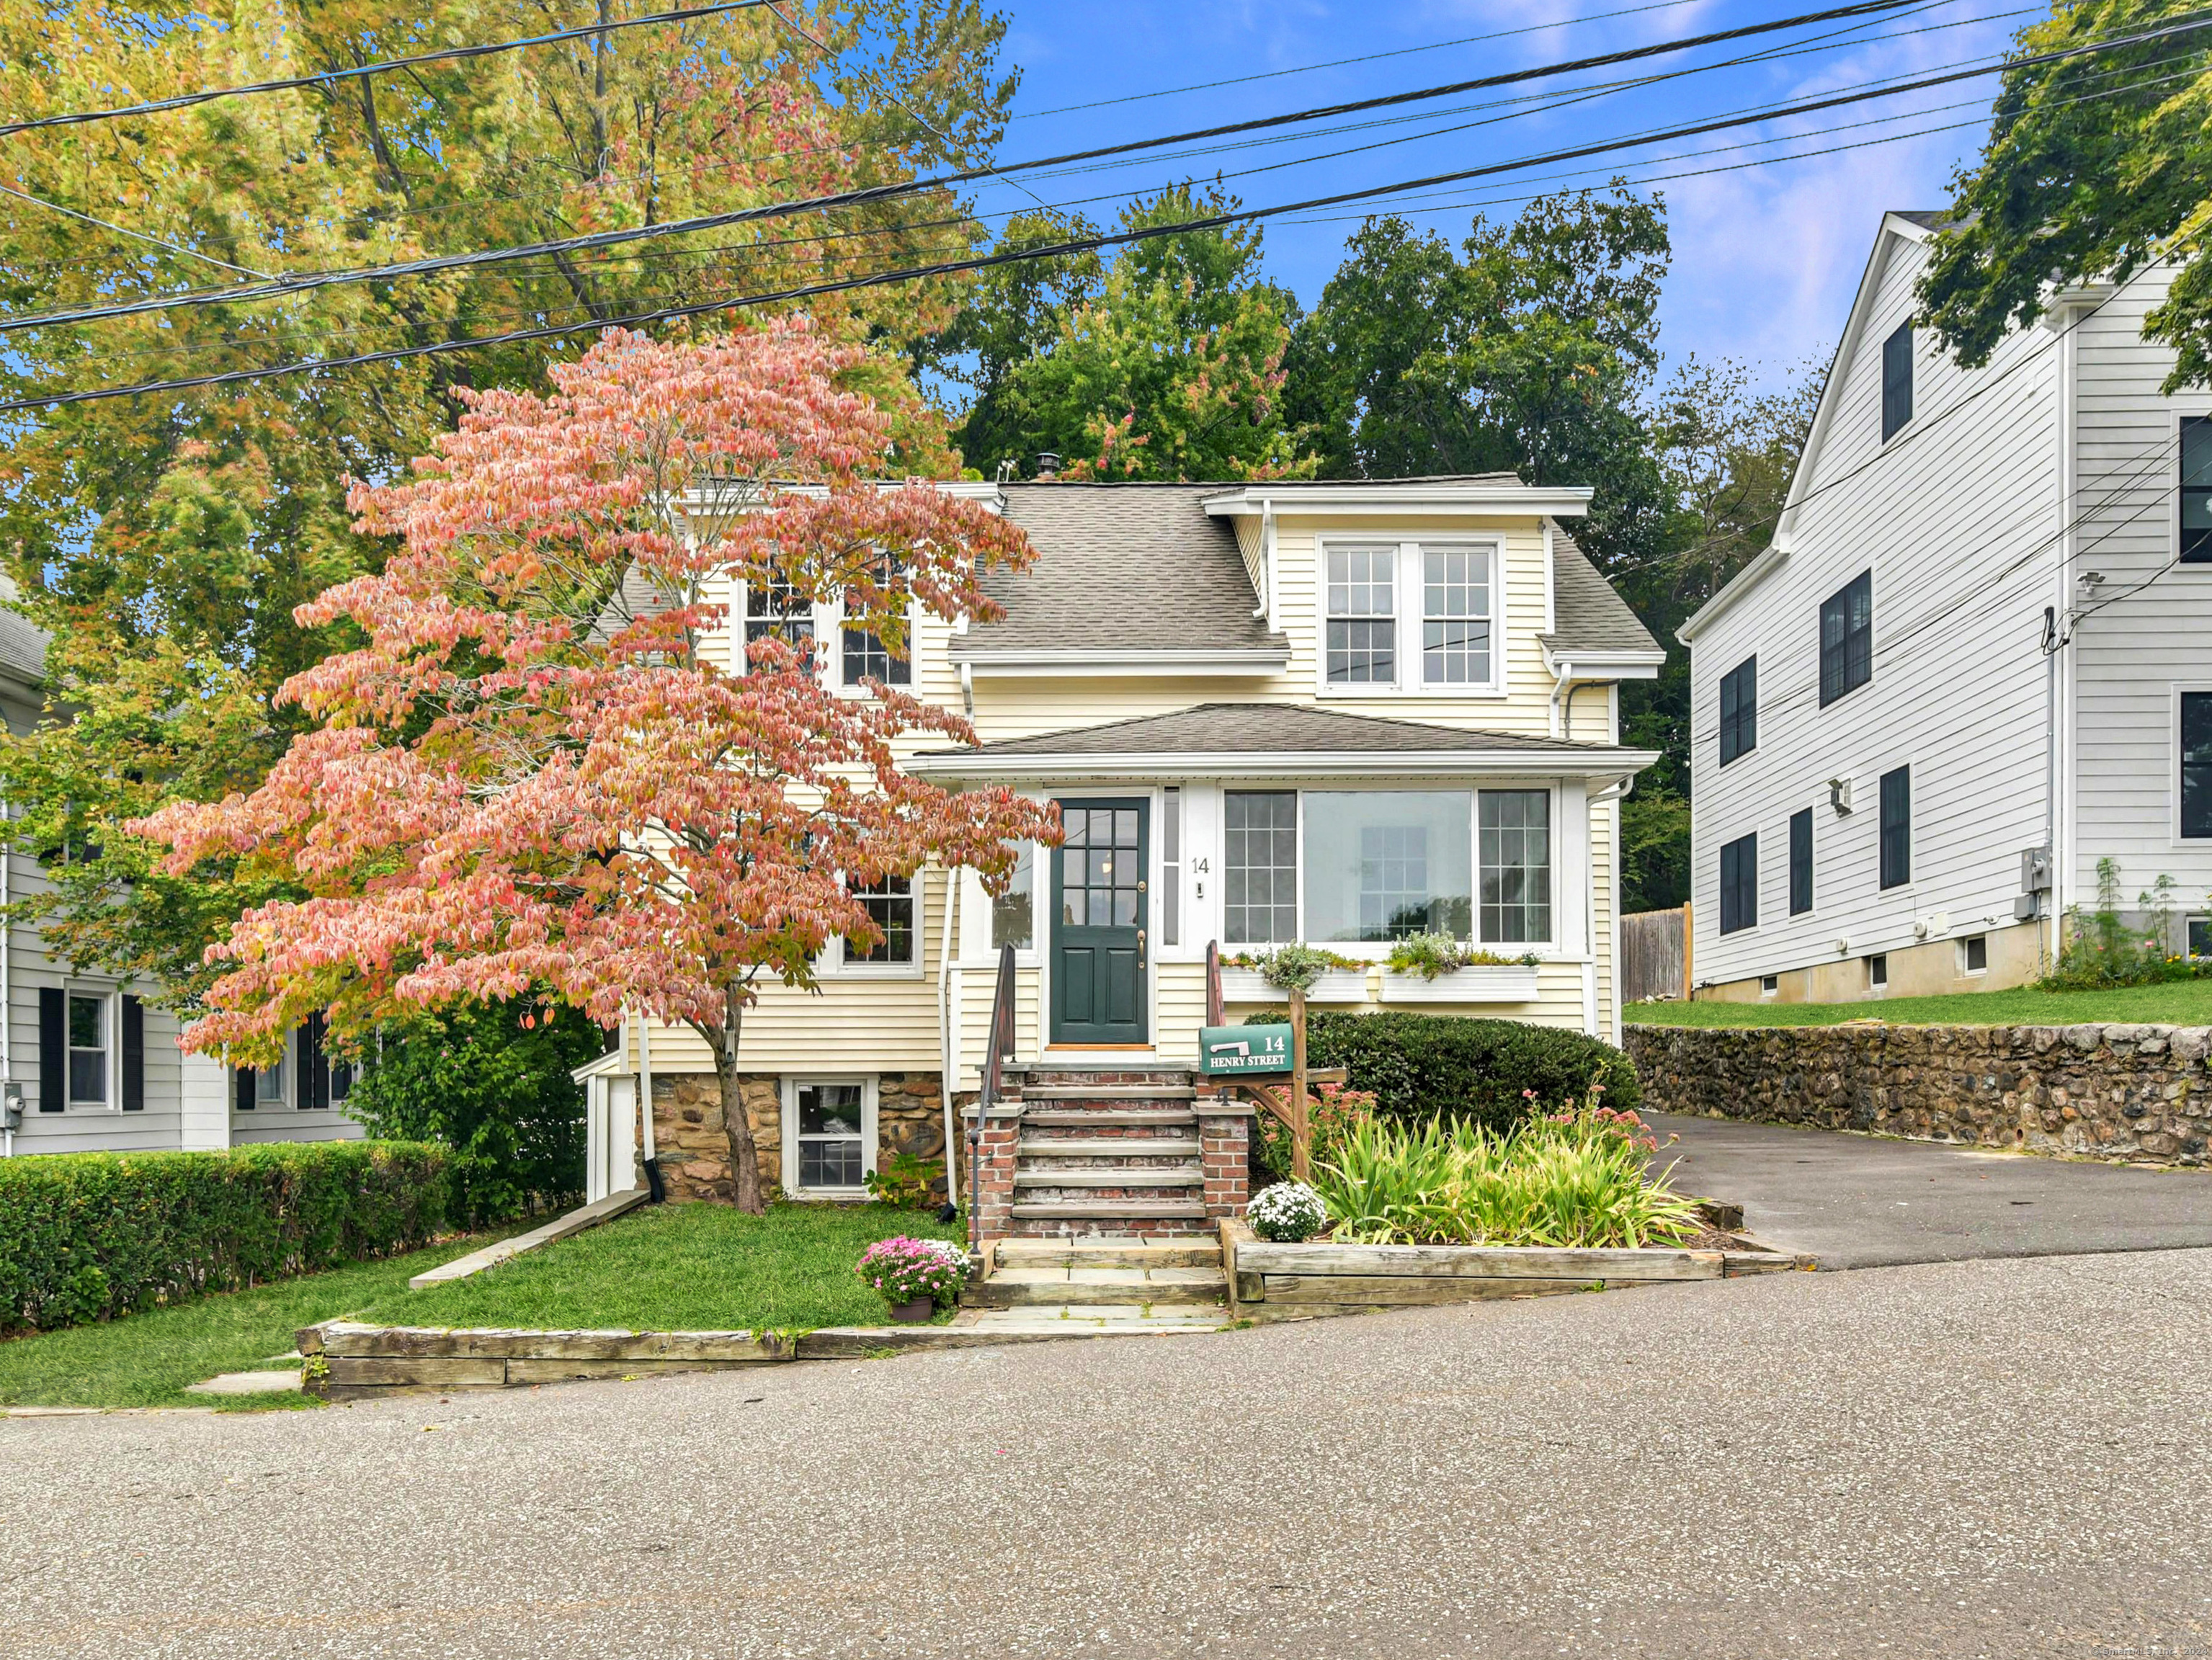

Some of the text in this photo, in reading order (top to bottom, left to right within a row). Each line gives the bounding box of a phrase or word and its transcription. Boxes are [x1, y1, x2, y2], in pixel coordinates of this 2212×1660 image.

[1192, 857, 1209, 873] 14
[1265, 1036, 1285, 1051] 14
[1210, 1055, 1285, 1068] HENRY STREET
